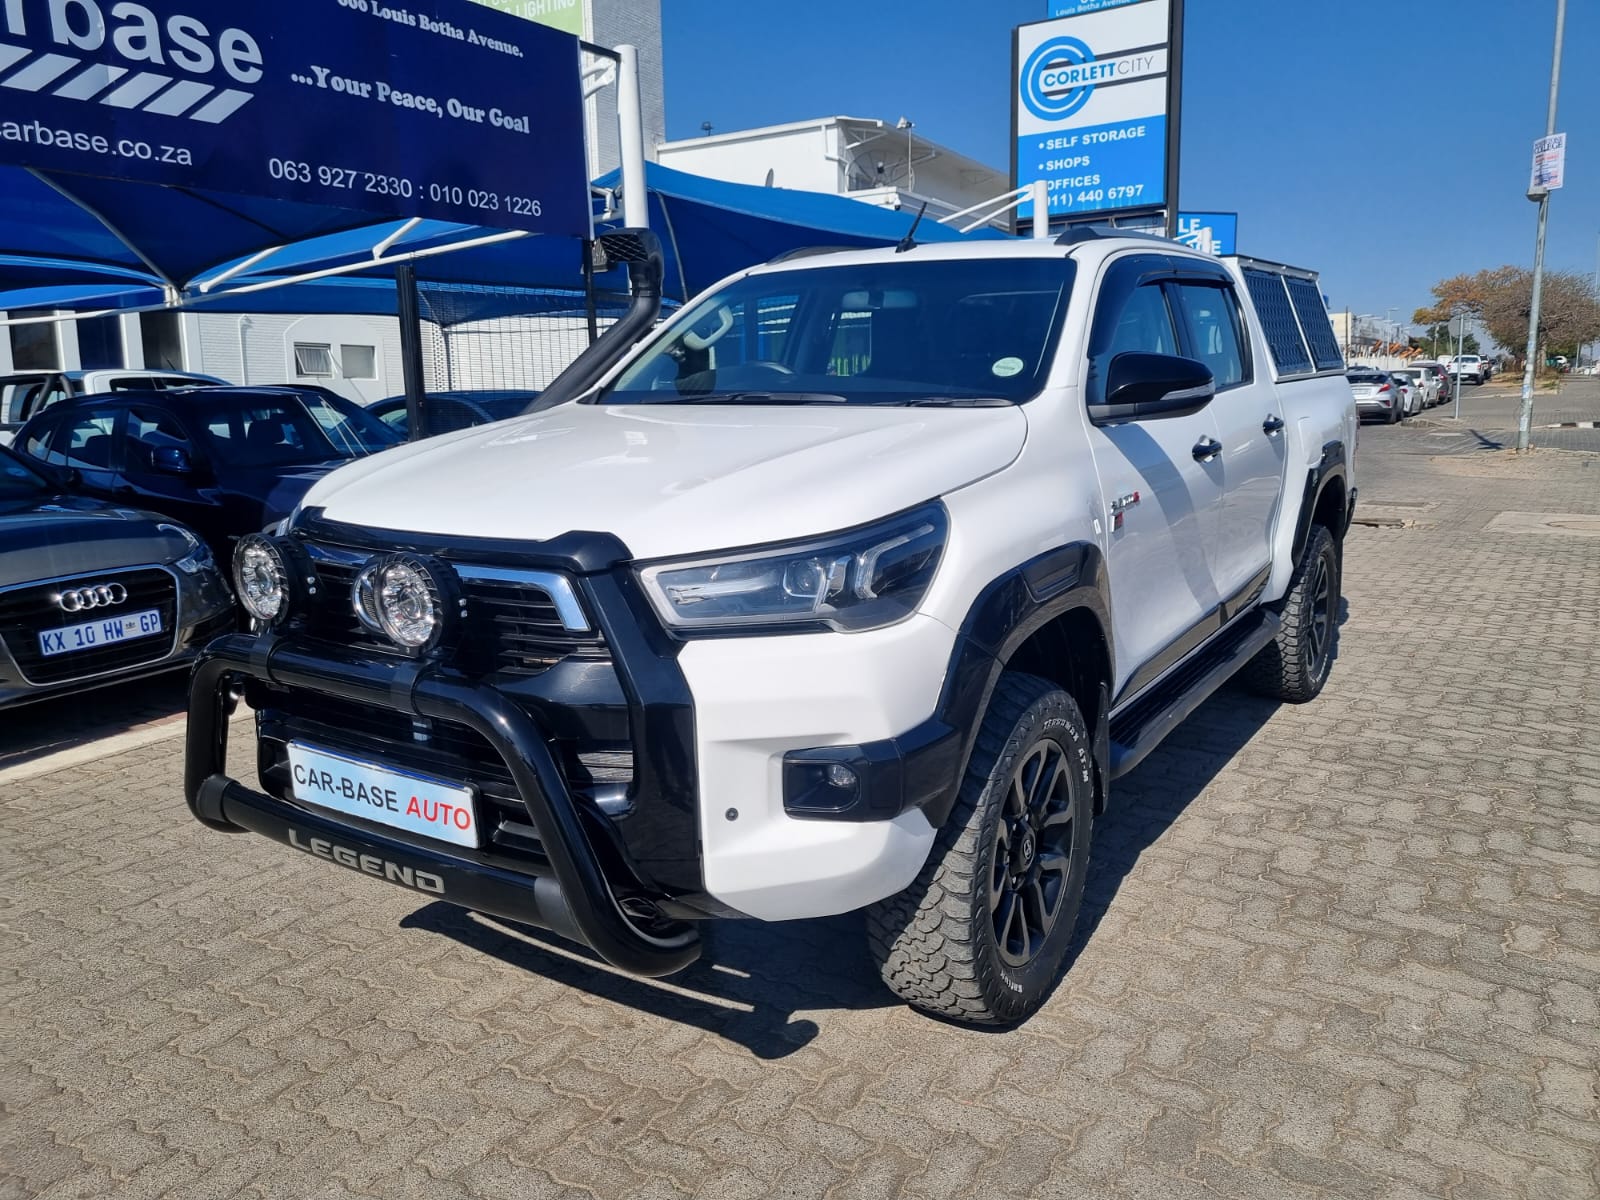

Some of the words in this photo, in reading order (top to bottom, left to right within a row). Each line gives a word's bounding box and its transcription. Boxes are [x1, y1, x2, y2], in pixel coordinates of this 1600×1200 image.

[371, 0, 416, 27] Louis
[418, 14, 465, 41] Botha
[467, 29, 524, 58] Avenue.
[291, 65, 371, 98] ...Your
[375, 81, 443, 118] Peace,
[447, 98, 485, 123] Our
[489, 108, 530, 134] Goal
[0, 120, 193, 166] arbase.co.za
[1046, 136, 1078, 150] SELF
[1082, 126, 1146, 145] STORAGE
[1046, 155, 1090, 171] SHOPS
[269, 158, 311, 183] 063
[318, 166, 357, 189] 927
[364, 173, 413, 198] 2330
[430, 183, 462, 205] 010
[468, 190, 499, 211] 023
[504, 196, 541, 217] 1226
[1077, 189, 1103, 203] 440
[1107, 184, 1144, 200] 6797
[42, 631, 66, 653] KX
[74, 626, 95, 646] 10
[103, 620, 124, 640] HW
[140, 613, 158, 632] GP
[293, 763, 399, 812] CAR-BASE
[406, 796, 471, 830] AUTO
[288, 827, 446, 894] LEGEND
